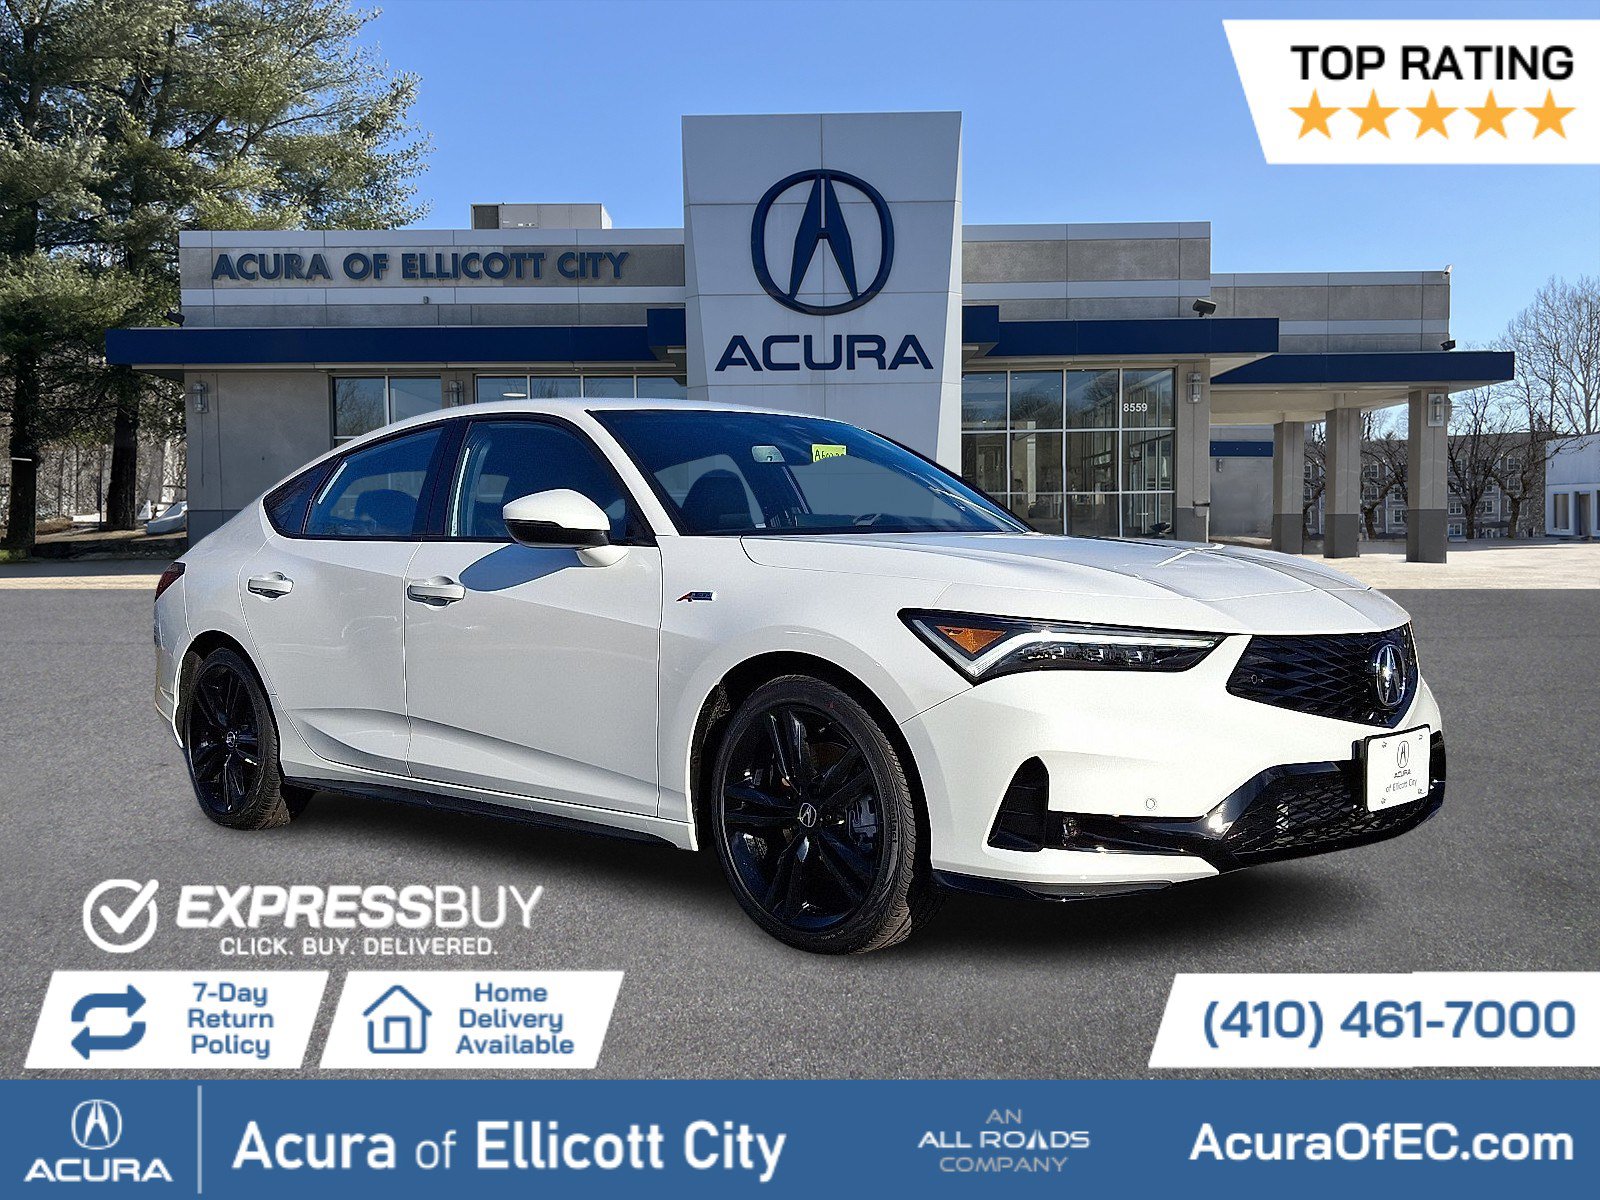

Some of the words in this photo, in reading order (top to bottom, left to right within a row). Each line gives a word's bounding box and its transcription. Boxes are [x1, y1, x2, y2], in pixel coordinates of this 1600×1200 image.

[212, 253, 332, 281] ACURA
[343, 253, 389, 280] OF
[402, 252, 546, 280] ELLICOTT
[557, 252, 630, 280] CITY
[715, 334, 934, 371] ACURA
[1123, 402, 1148, 412] 8559
